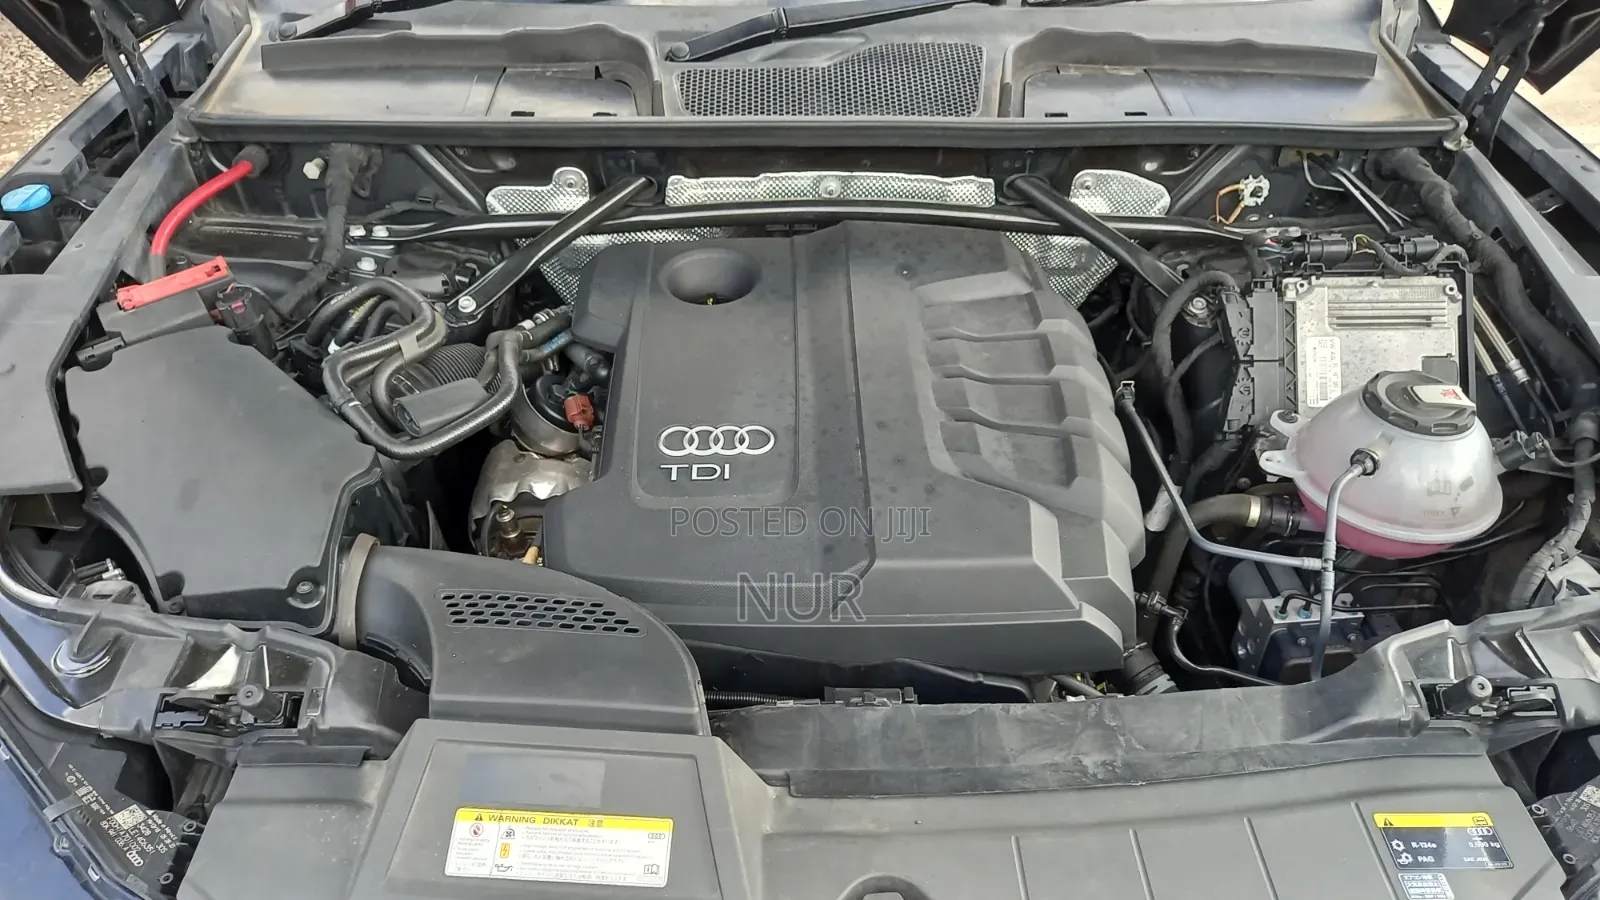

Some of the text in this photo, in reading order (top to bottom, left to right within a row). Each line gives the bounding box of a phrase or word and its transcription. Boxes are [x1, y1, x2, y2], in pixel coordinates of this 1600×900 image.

[660, 463, 730, 481] TDI
[488, 814, 580, 826] WARNING DIKKAT
[1410, 841, 1438, 849] R-134a
[1490, 841, 1500, 849] kg
[1417, 855, 1435, 863] PAG
